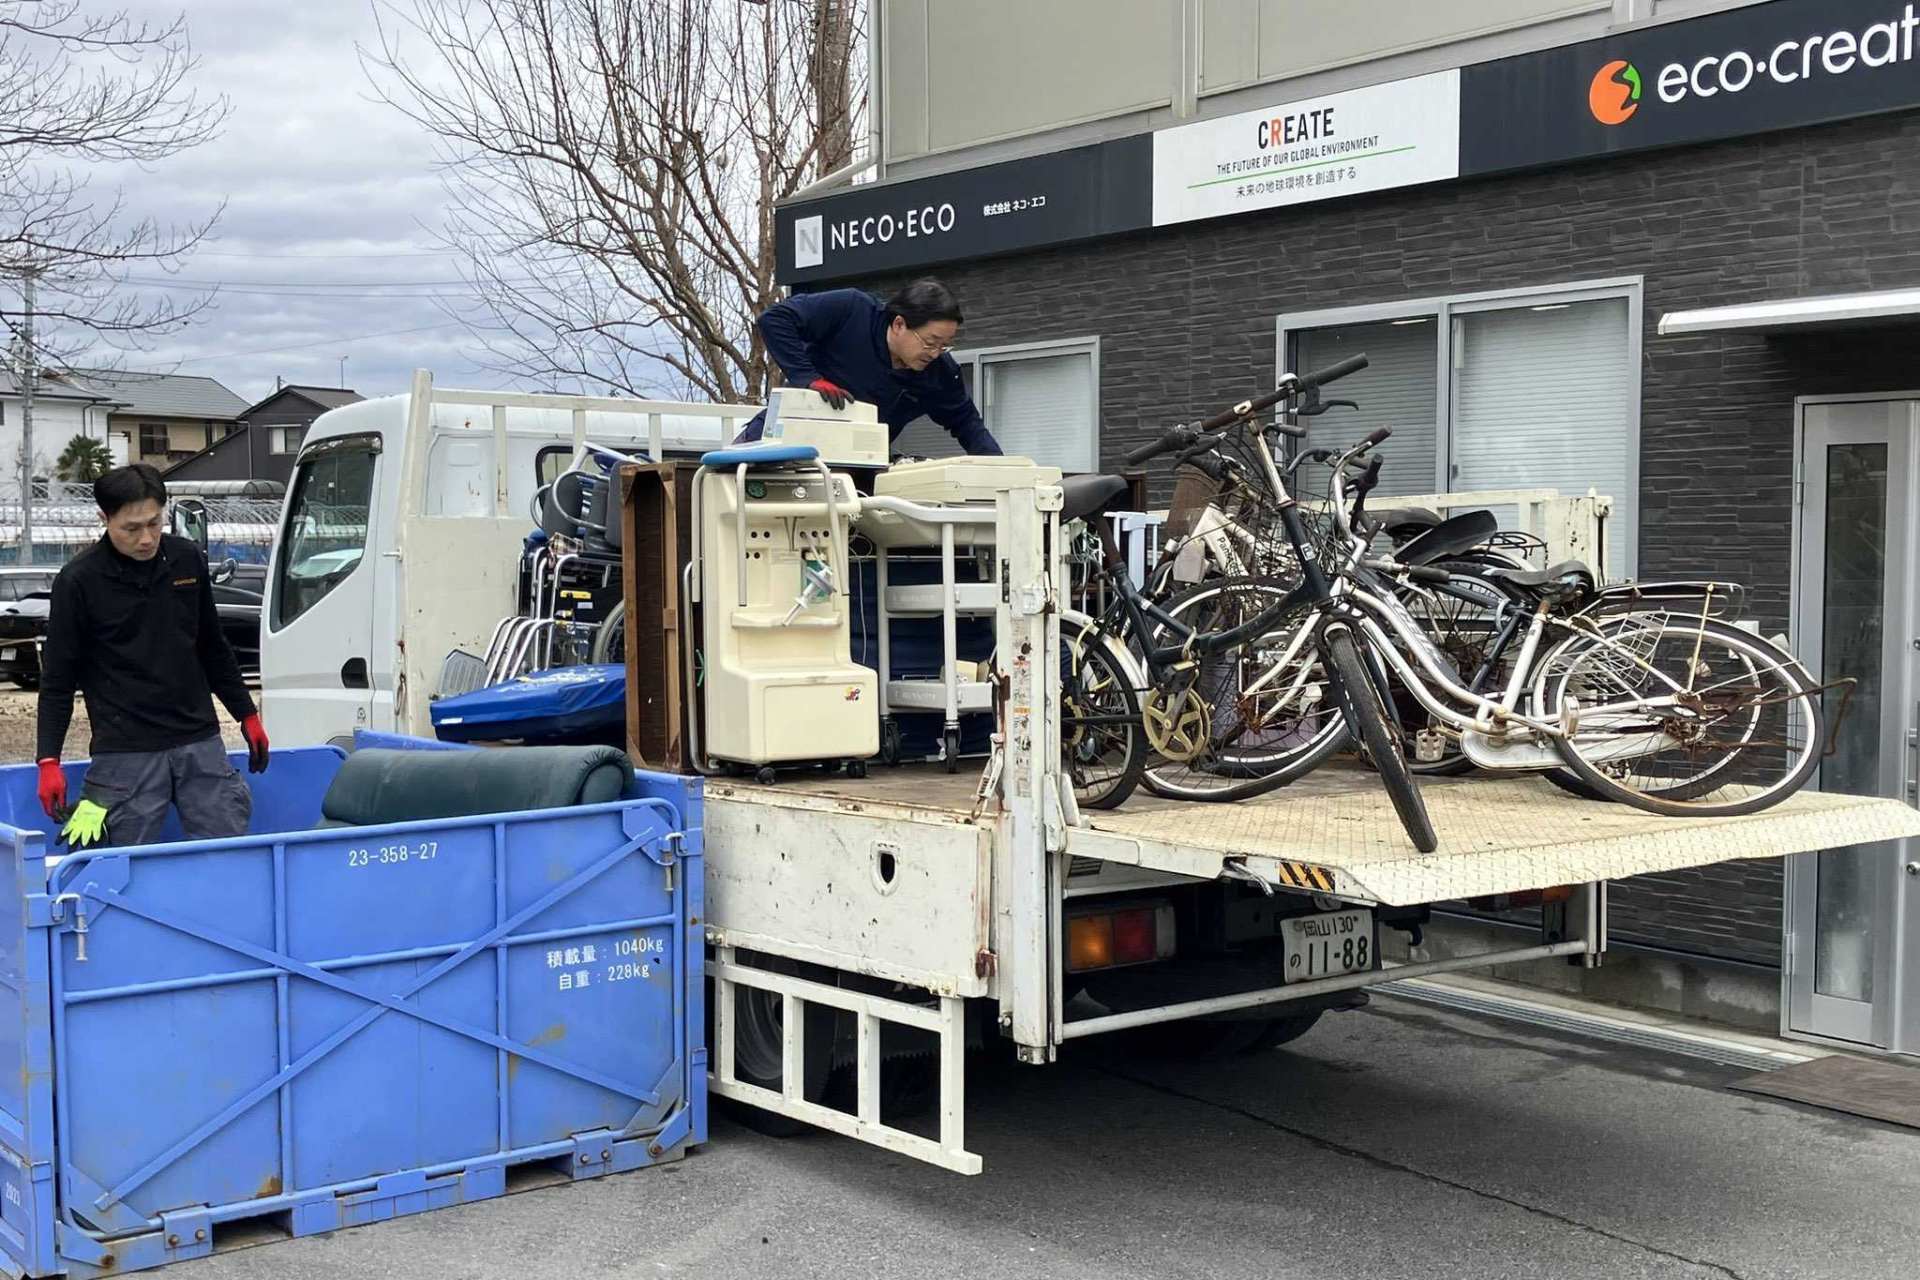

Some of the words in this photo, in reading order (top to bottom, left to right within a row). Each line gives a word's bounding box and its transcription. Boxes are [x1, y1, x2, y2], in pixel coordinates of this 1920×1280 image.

[1257, 107, 1335, 150] CREATE
[1216, 162, 1231, 175] THE
[1232, 157, 1261, 173] FUTURE
[1262, 155, 1273, 168] OF
[1273, 152, 1289, 165] OUR
[1290, 147, 1320, 162] GLOBAL
[1321, 135, 1379, 156] ENVIRONMENT
[1235, 166, 1357, 199] 未来の地球環境を創造する
[348, 842, 438, 867] 23-358-27
[614, 937, 664, 956] 1040kg
[607, 963, 650, 982] 228kg
